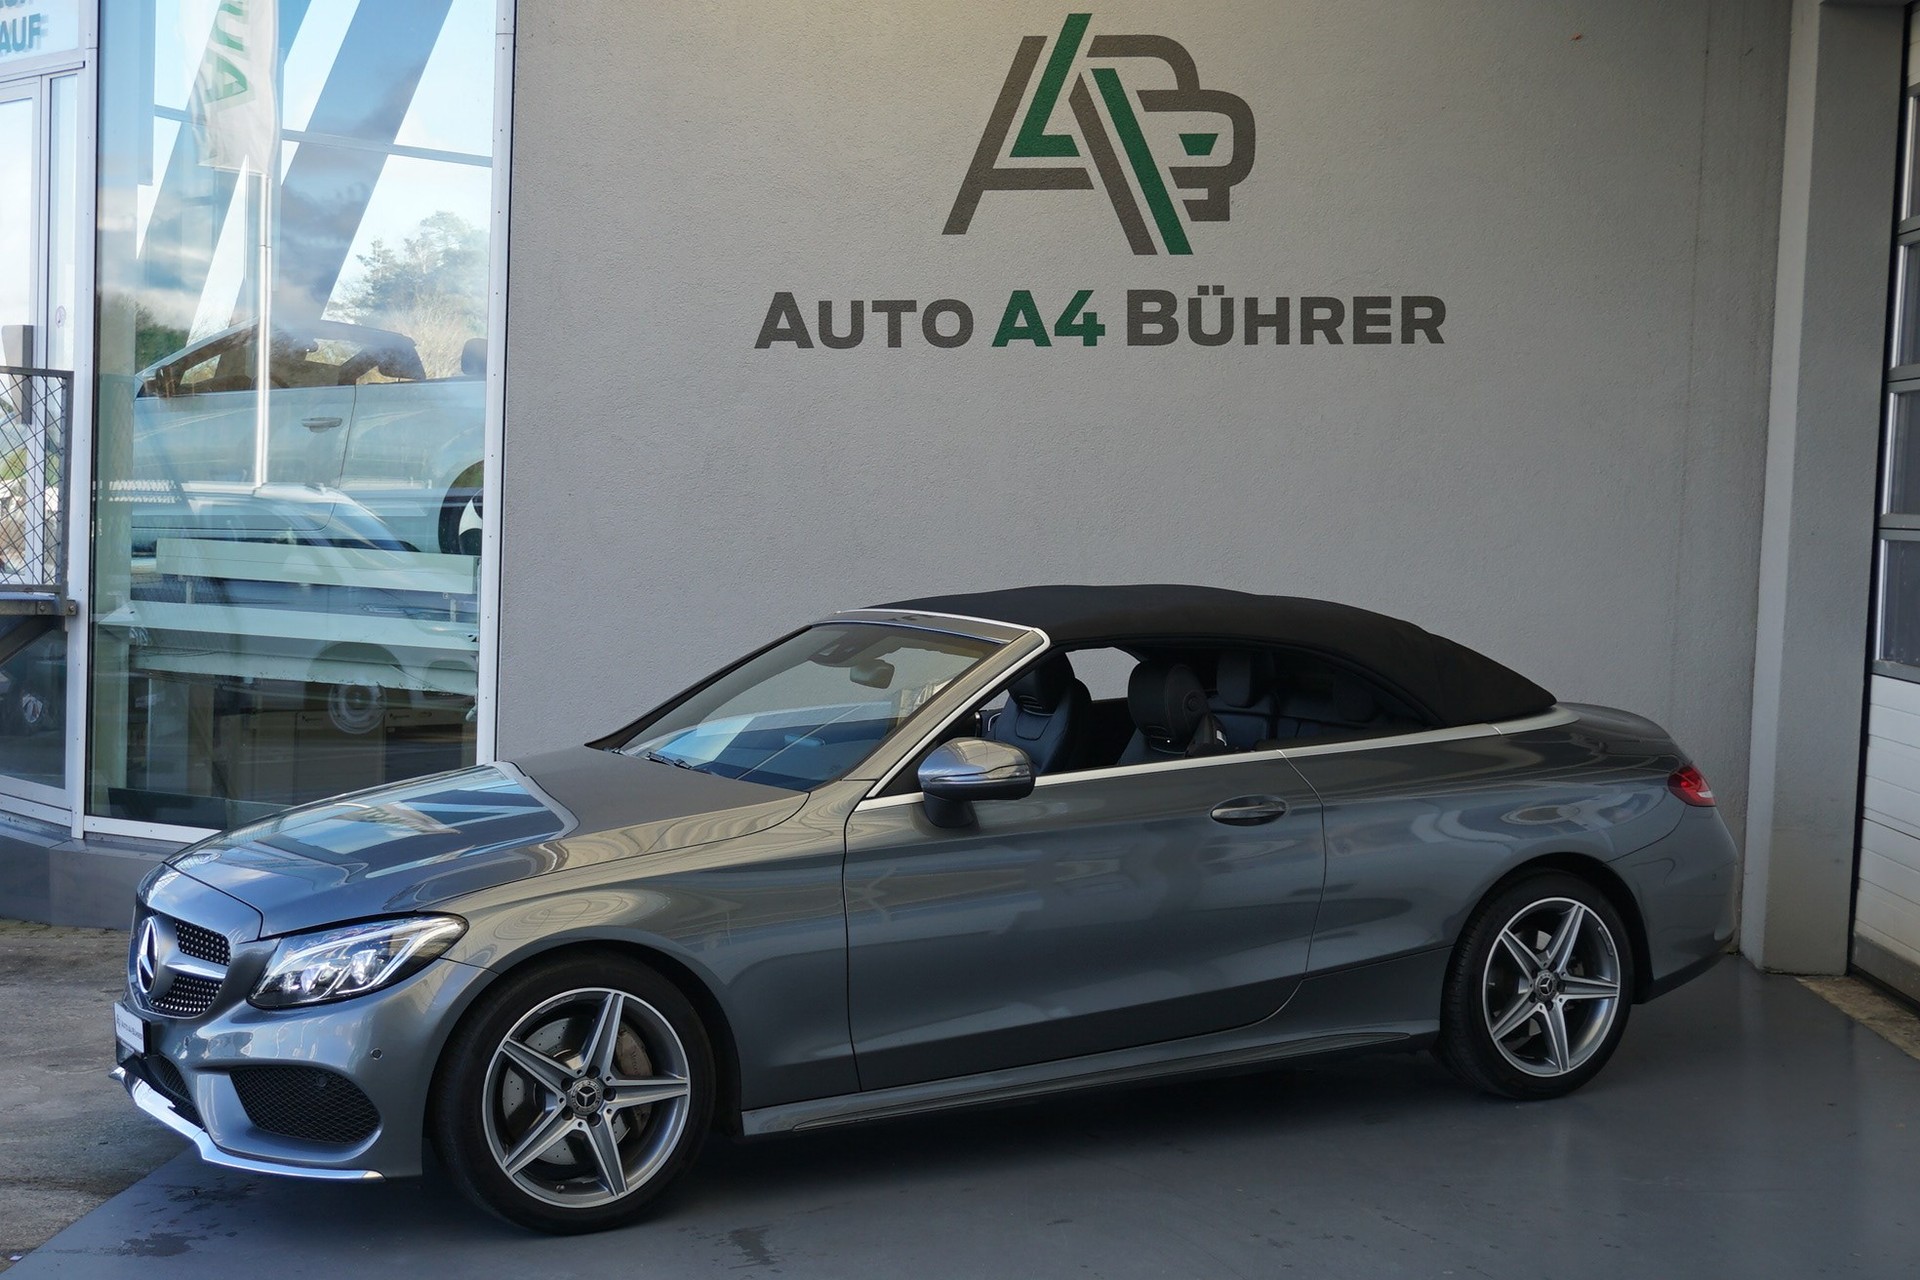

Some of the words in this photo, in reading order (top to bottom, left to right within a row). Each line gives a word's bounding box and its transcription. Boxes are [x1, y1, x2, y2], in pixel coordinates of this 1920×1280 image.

[754, 291, 974, 350] AUTO
[991, 289, 1106, 348] A4
[1126, 284, 1447, 347] BÜHRER
